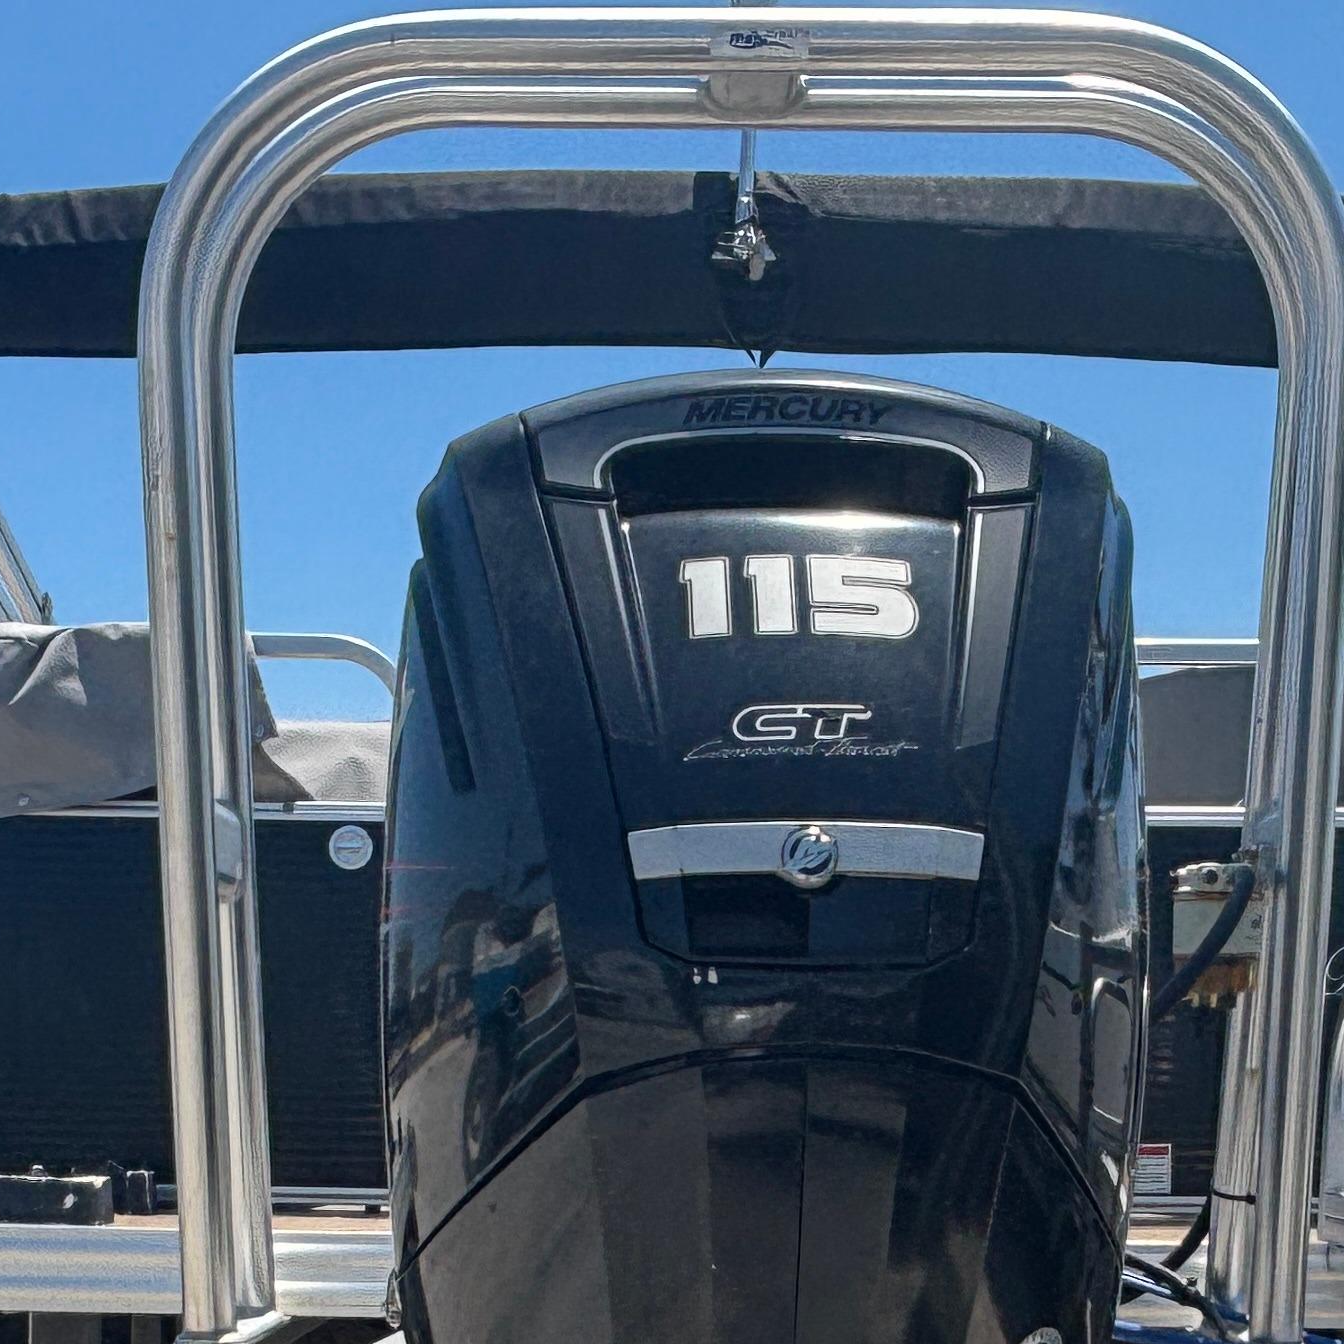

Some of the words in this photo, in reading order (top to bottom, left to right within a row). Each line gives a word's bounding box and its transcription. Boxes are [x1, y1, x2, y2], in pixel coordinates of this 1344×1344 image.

[682, 396, 894, 427] MERCURY
[679, 554, 920, 640] 115
[732, 703, 873, 741] GT
